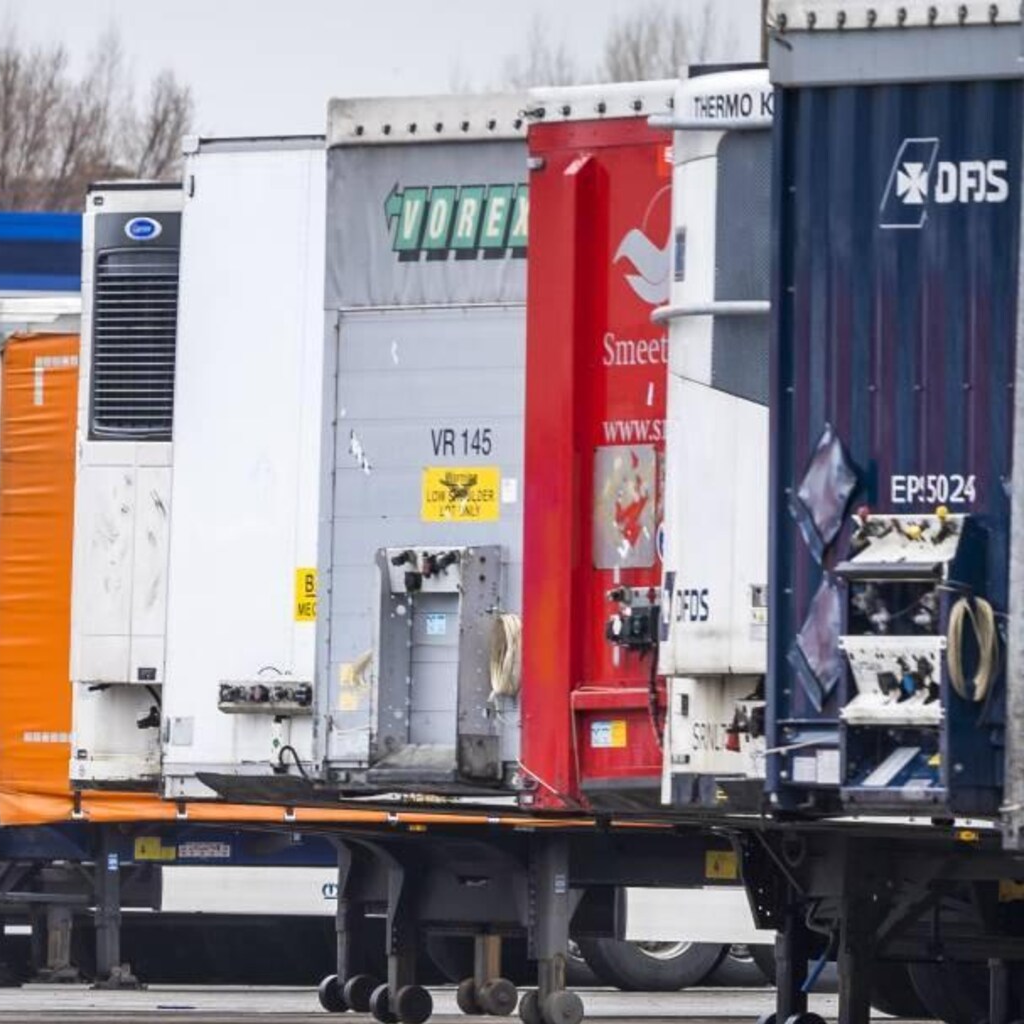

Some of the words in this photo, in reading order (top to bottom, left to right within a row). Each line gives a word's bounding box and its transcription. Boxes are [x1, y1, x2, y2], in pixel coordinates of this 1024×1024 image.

[694, 93, 753, 118] THERMO
[935, 159, 1009, 204] DFDS
[403, 196, 528, 239] VOREX
[431, 428, 455, 456] VR
[461, 428, 492, 456] 145
